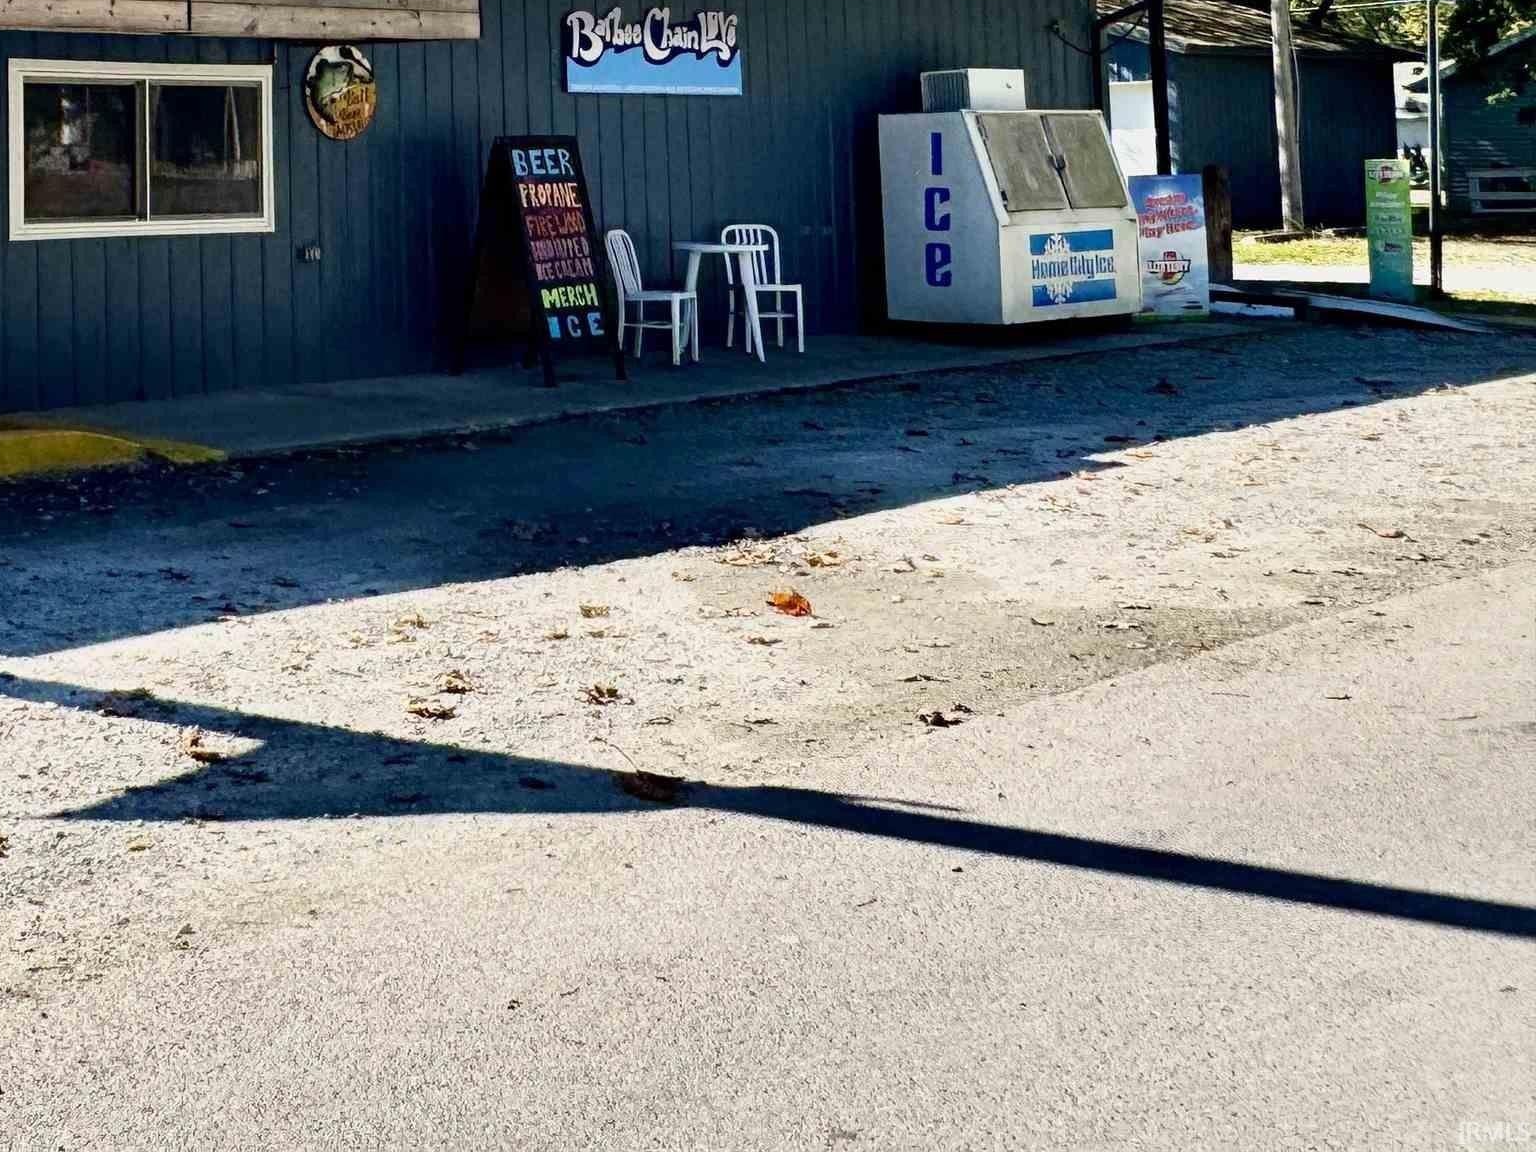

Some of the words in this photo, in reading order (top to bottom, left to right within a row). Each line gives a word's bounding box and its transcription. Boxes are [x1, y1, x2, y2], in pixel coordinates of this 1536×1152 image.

[644, 8, 700, 61] Chain
[512, 148, 576, 177] BEER
[518, 182, 582, 208] PROPANE
[541, 283, 599, 308] MERCH
[547, 312, 604, 338] ICE
